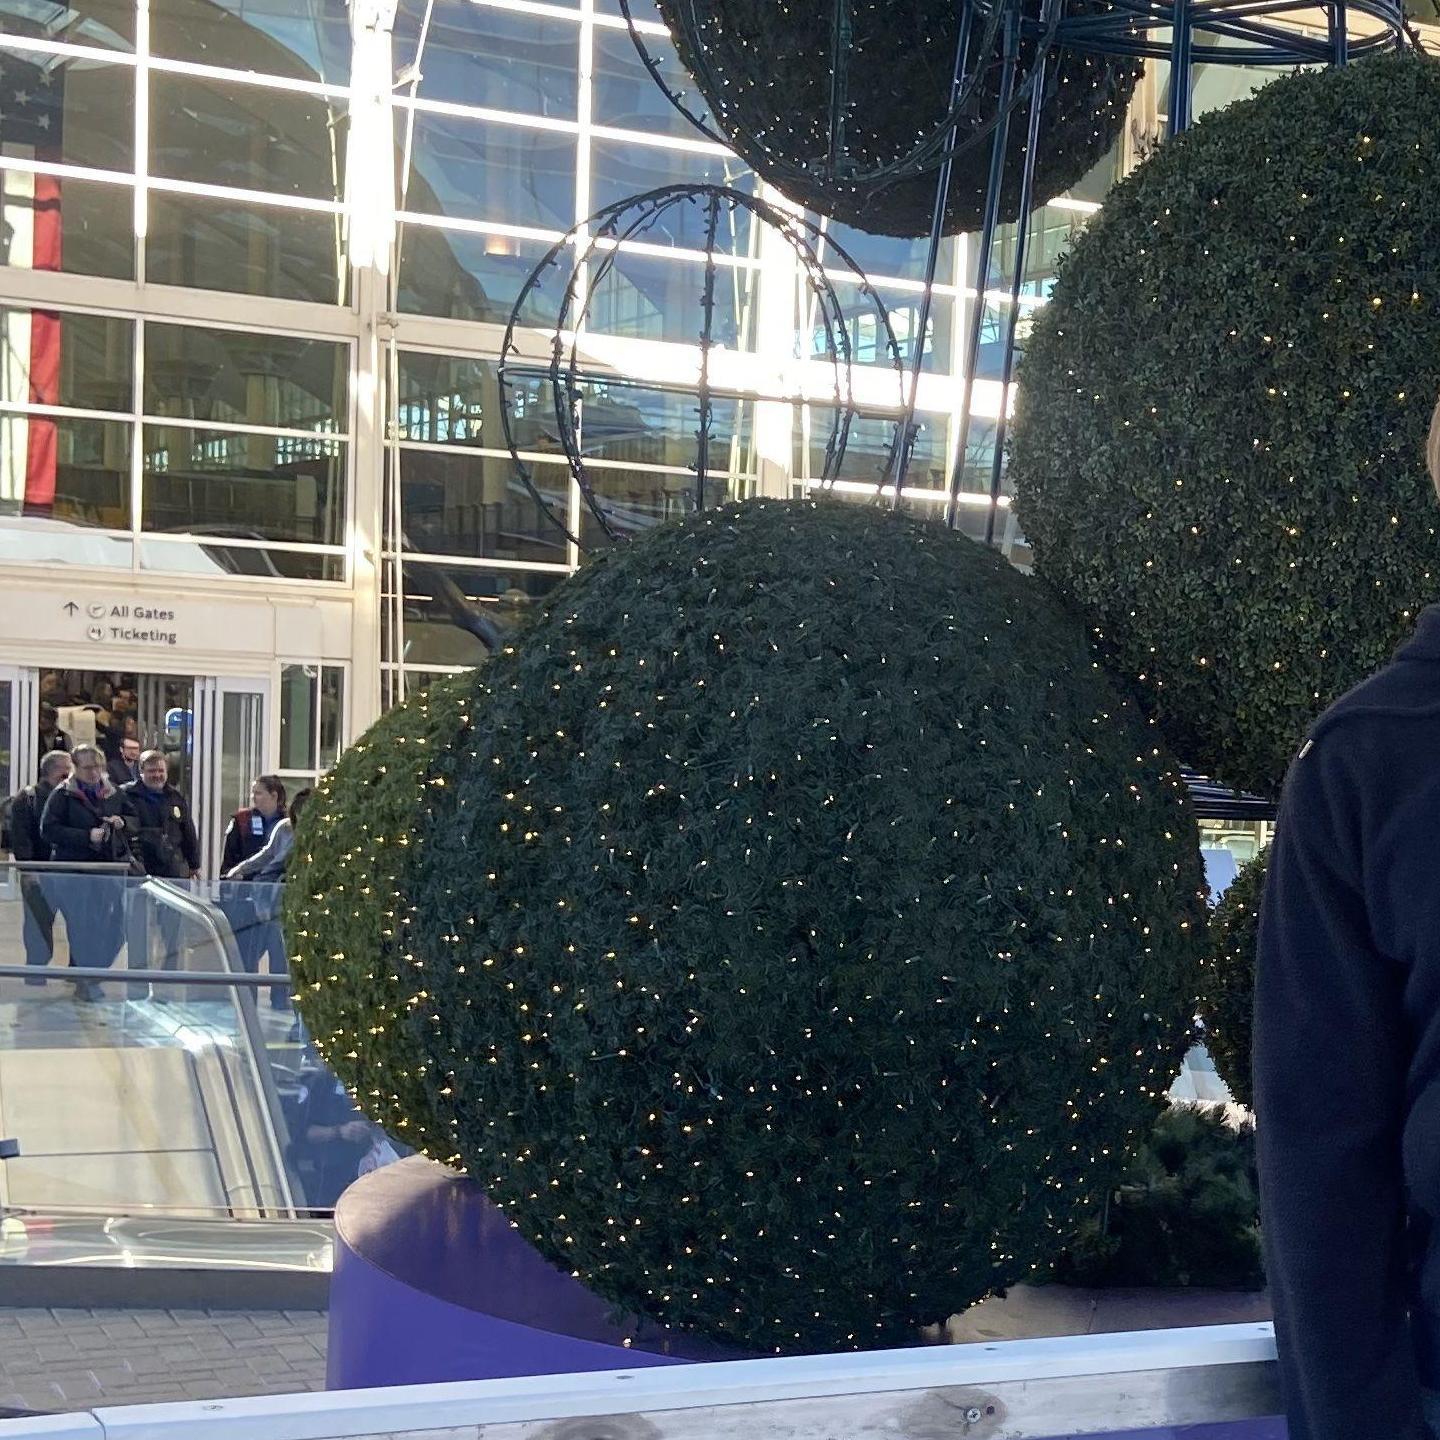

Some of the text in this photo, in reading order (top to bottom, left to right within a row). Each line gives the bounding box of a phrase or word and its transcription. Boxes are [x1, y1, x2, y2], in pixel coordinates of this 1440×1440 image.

[110, 605, 175, 620] All Gates
[110, 627, 177, 644] Ticketing
